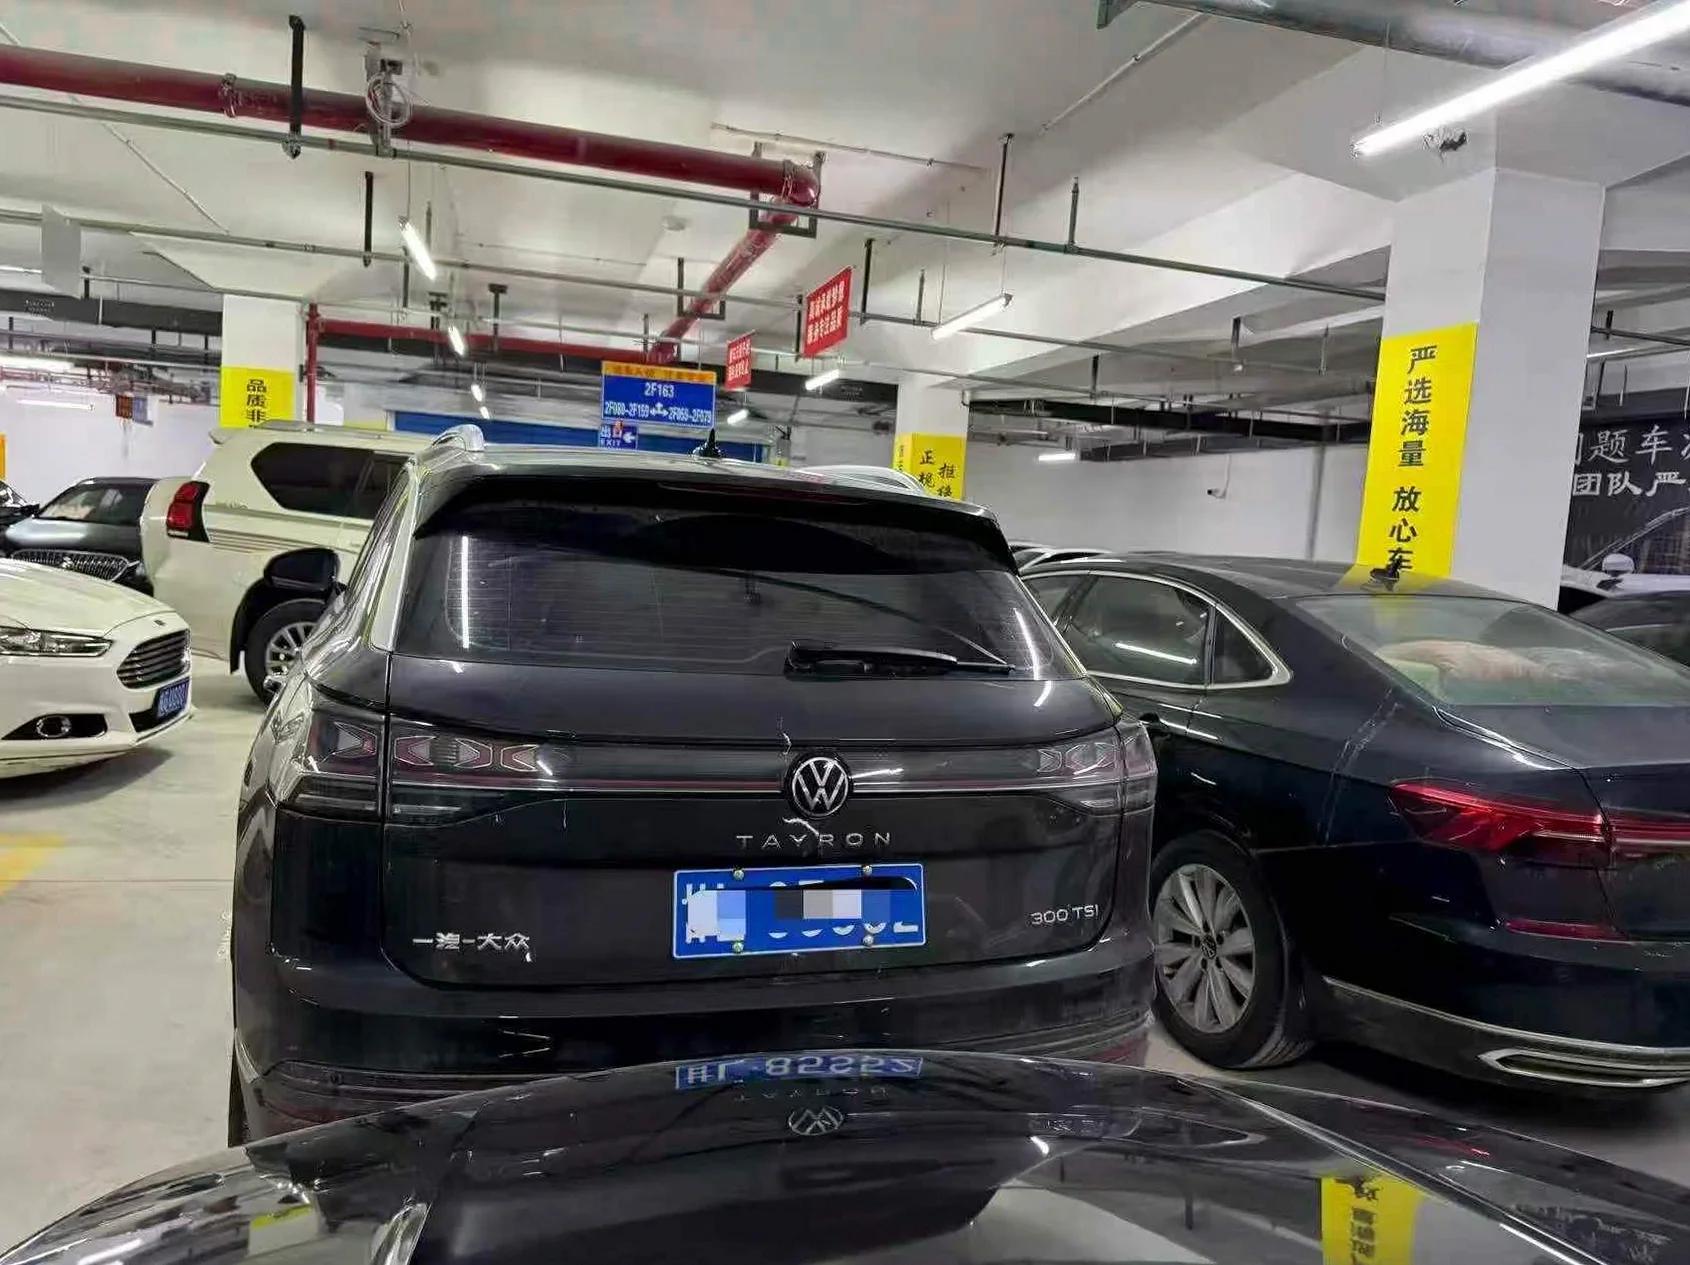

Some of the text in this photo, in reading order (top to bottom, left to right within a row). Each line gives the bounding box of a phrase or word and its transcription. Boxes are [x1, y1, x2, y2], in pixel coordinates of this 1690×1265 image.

[644, 382, 674, 397] 2F163
[246, 379, 267, 427] 品质非
[1397, 345, 1437, 467] 严选海量
[1575, 424, 1690, 465] 题车
[1573, 471, 1686, 497] 团队严
[736, 832, 890, 850] TAYRON
[1030, 904, 1099, 925] 300 TSI
